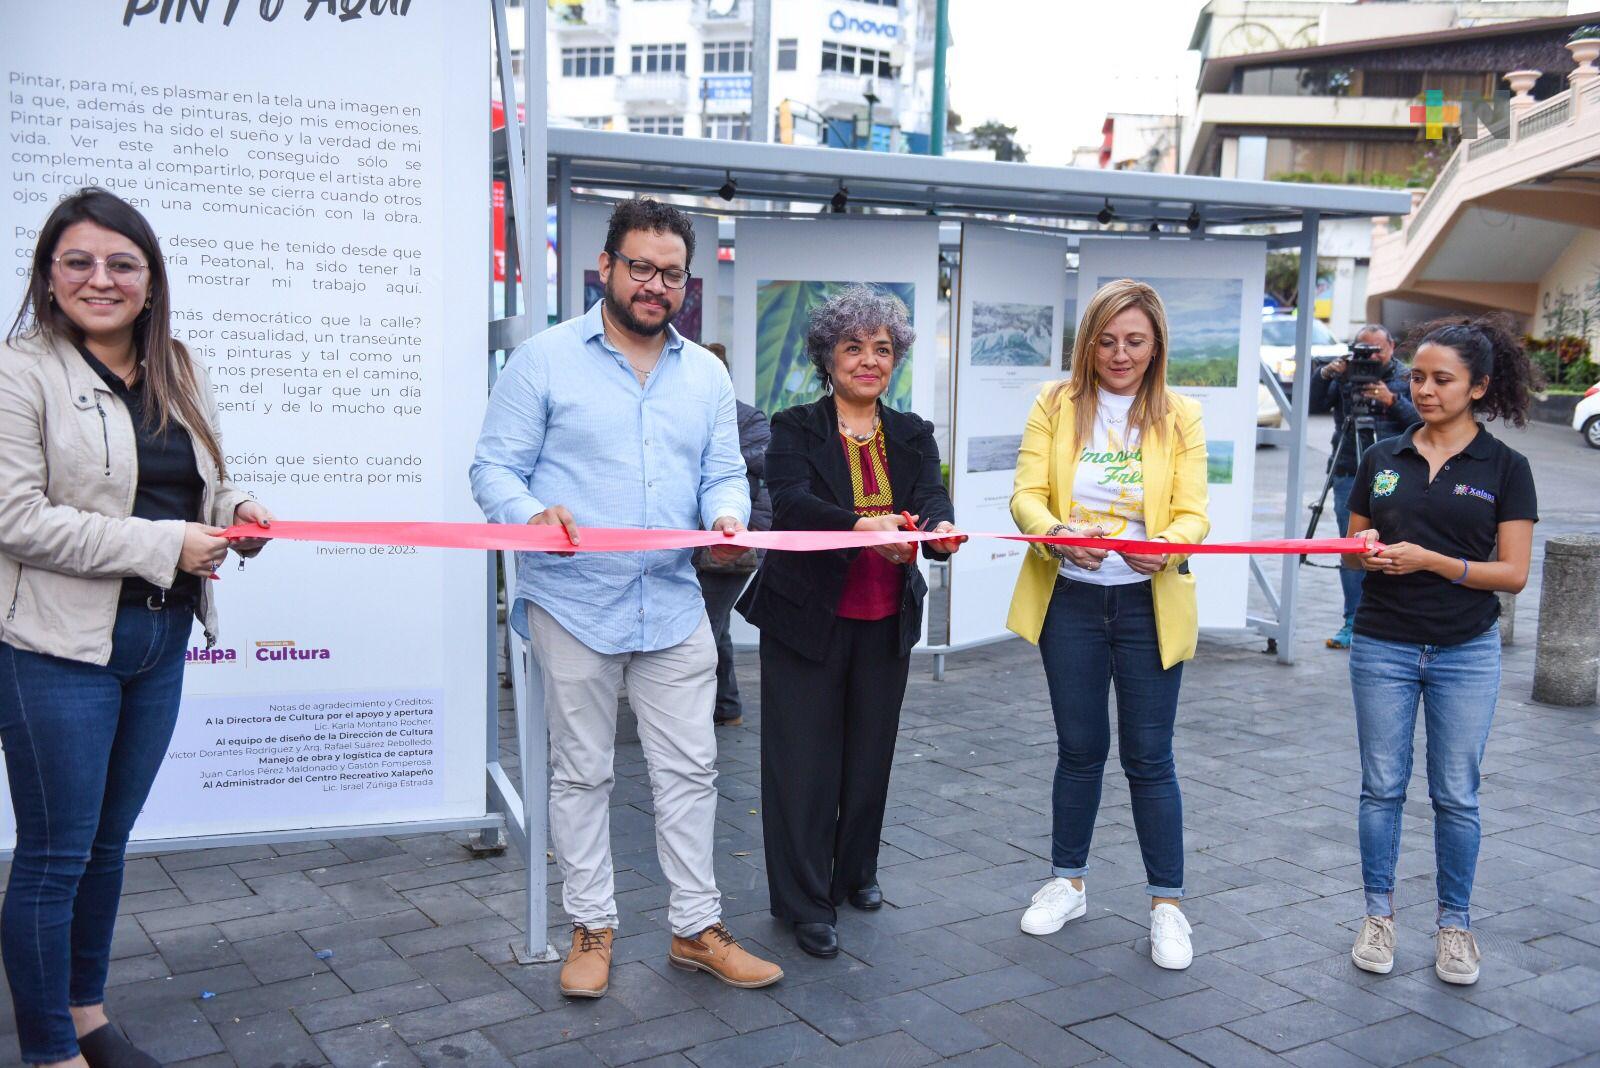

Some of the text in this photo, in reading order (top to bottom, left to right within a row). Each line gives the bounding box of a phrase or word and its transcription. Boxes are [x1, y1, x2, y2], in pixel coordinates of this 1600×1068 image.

[8, 71, 422, 117] Pintar, para mí, es plasmar en la tela una imagen en
[10, 91, 422, 134] la que, además de pinturas, dejo mis emociones.
[10, 111, 422, 152] Pintar paisajes ha sido el sueño y la verdad de mi
[10, 131, 422, 170] vida. Ver este anhelo conseguido sólo se
[12, 153, 422, 188] complementa al compartirlo, porque el artista abre
[12, 171, 422, 206] un círculo que únicamente se cierra cuando otros
[12, 188, 48, 205] ojos
[160, 199, 192, 211] una
[202, 201, 316, 218] comunicación
[324, 208, 354, 220] con
[362, 208, 376, 221] la
[384, 209, 422, 224] obra.
[168, 233, 218, 248] deseo
[222, 238, 254, 252] que
[260, 237, 280, 251] he
[286, 238, 336, 254] tenido
[340, 241, 388, 256] desde
[392, 247, 422, 261] que
[162, 252, 422, 276] ería Peatonal, ha sido tener la
[188, 272, 422, 296] mostrar mi trabajo aquí.
[170, 307, 422, 328] más democrático que la calle?
[188, 328, 214, 342] por
[220, 328, 308, 346] casualidad,
[314, 332, 334, 343] un
[340, 330, 422, 346] transeúnte
[196, 344, 422, 364] is pinturas y tal como un
[218, 365, 246, 376] nos
[250, 364, 318, 380] presenta
[322, 368, 342, 378] en
[346, 366, 358, 379] el
[362, 367, 422, 384] camino,
[240, 381, 264, 395] del
[282, 382, 322, 399] lugar
[332, 386, 362, 400] que
[370, 386, 390, 397] un
[398, 384, 422, 398] día
[218, 398, 422, 417] sentí y de lo mucho que
[224, 452, 422, 468] oción que siento cuando
[232, 469, 422, 486] paisaje que entra por mis
[316, 544, 418, 555] Invierno de 2023.
[184, 647, 237, 664] alapa
[256, 647, 331, 662] Cultura
[216, 716, 224, 725] la
[226, 715, 272, 725] Directora
[274, 714, 286, 722] de
[288, 712, 324, 722] Cultura
[326, 712, 342, 722] por
[345, 710, 354, 719] el
[356, 710, 384, 720] apoyo
[394, 707, 433, 719] apertura
[216, 727, 433, 747] Al equipo de diseño de la Dirección de Cultura
[202, 767, 434, 789] Al Administrador del Centro Recreativo Xalapeño
